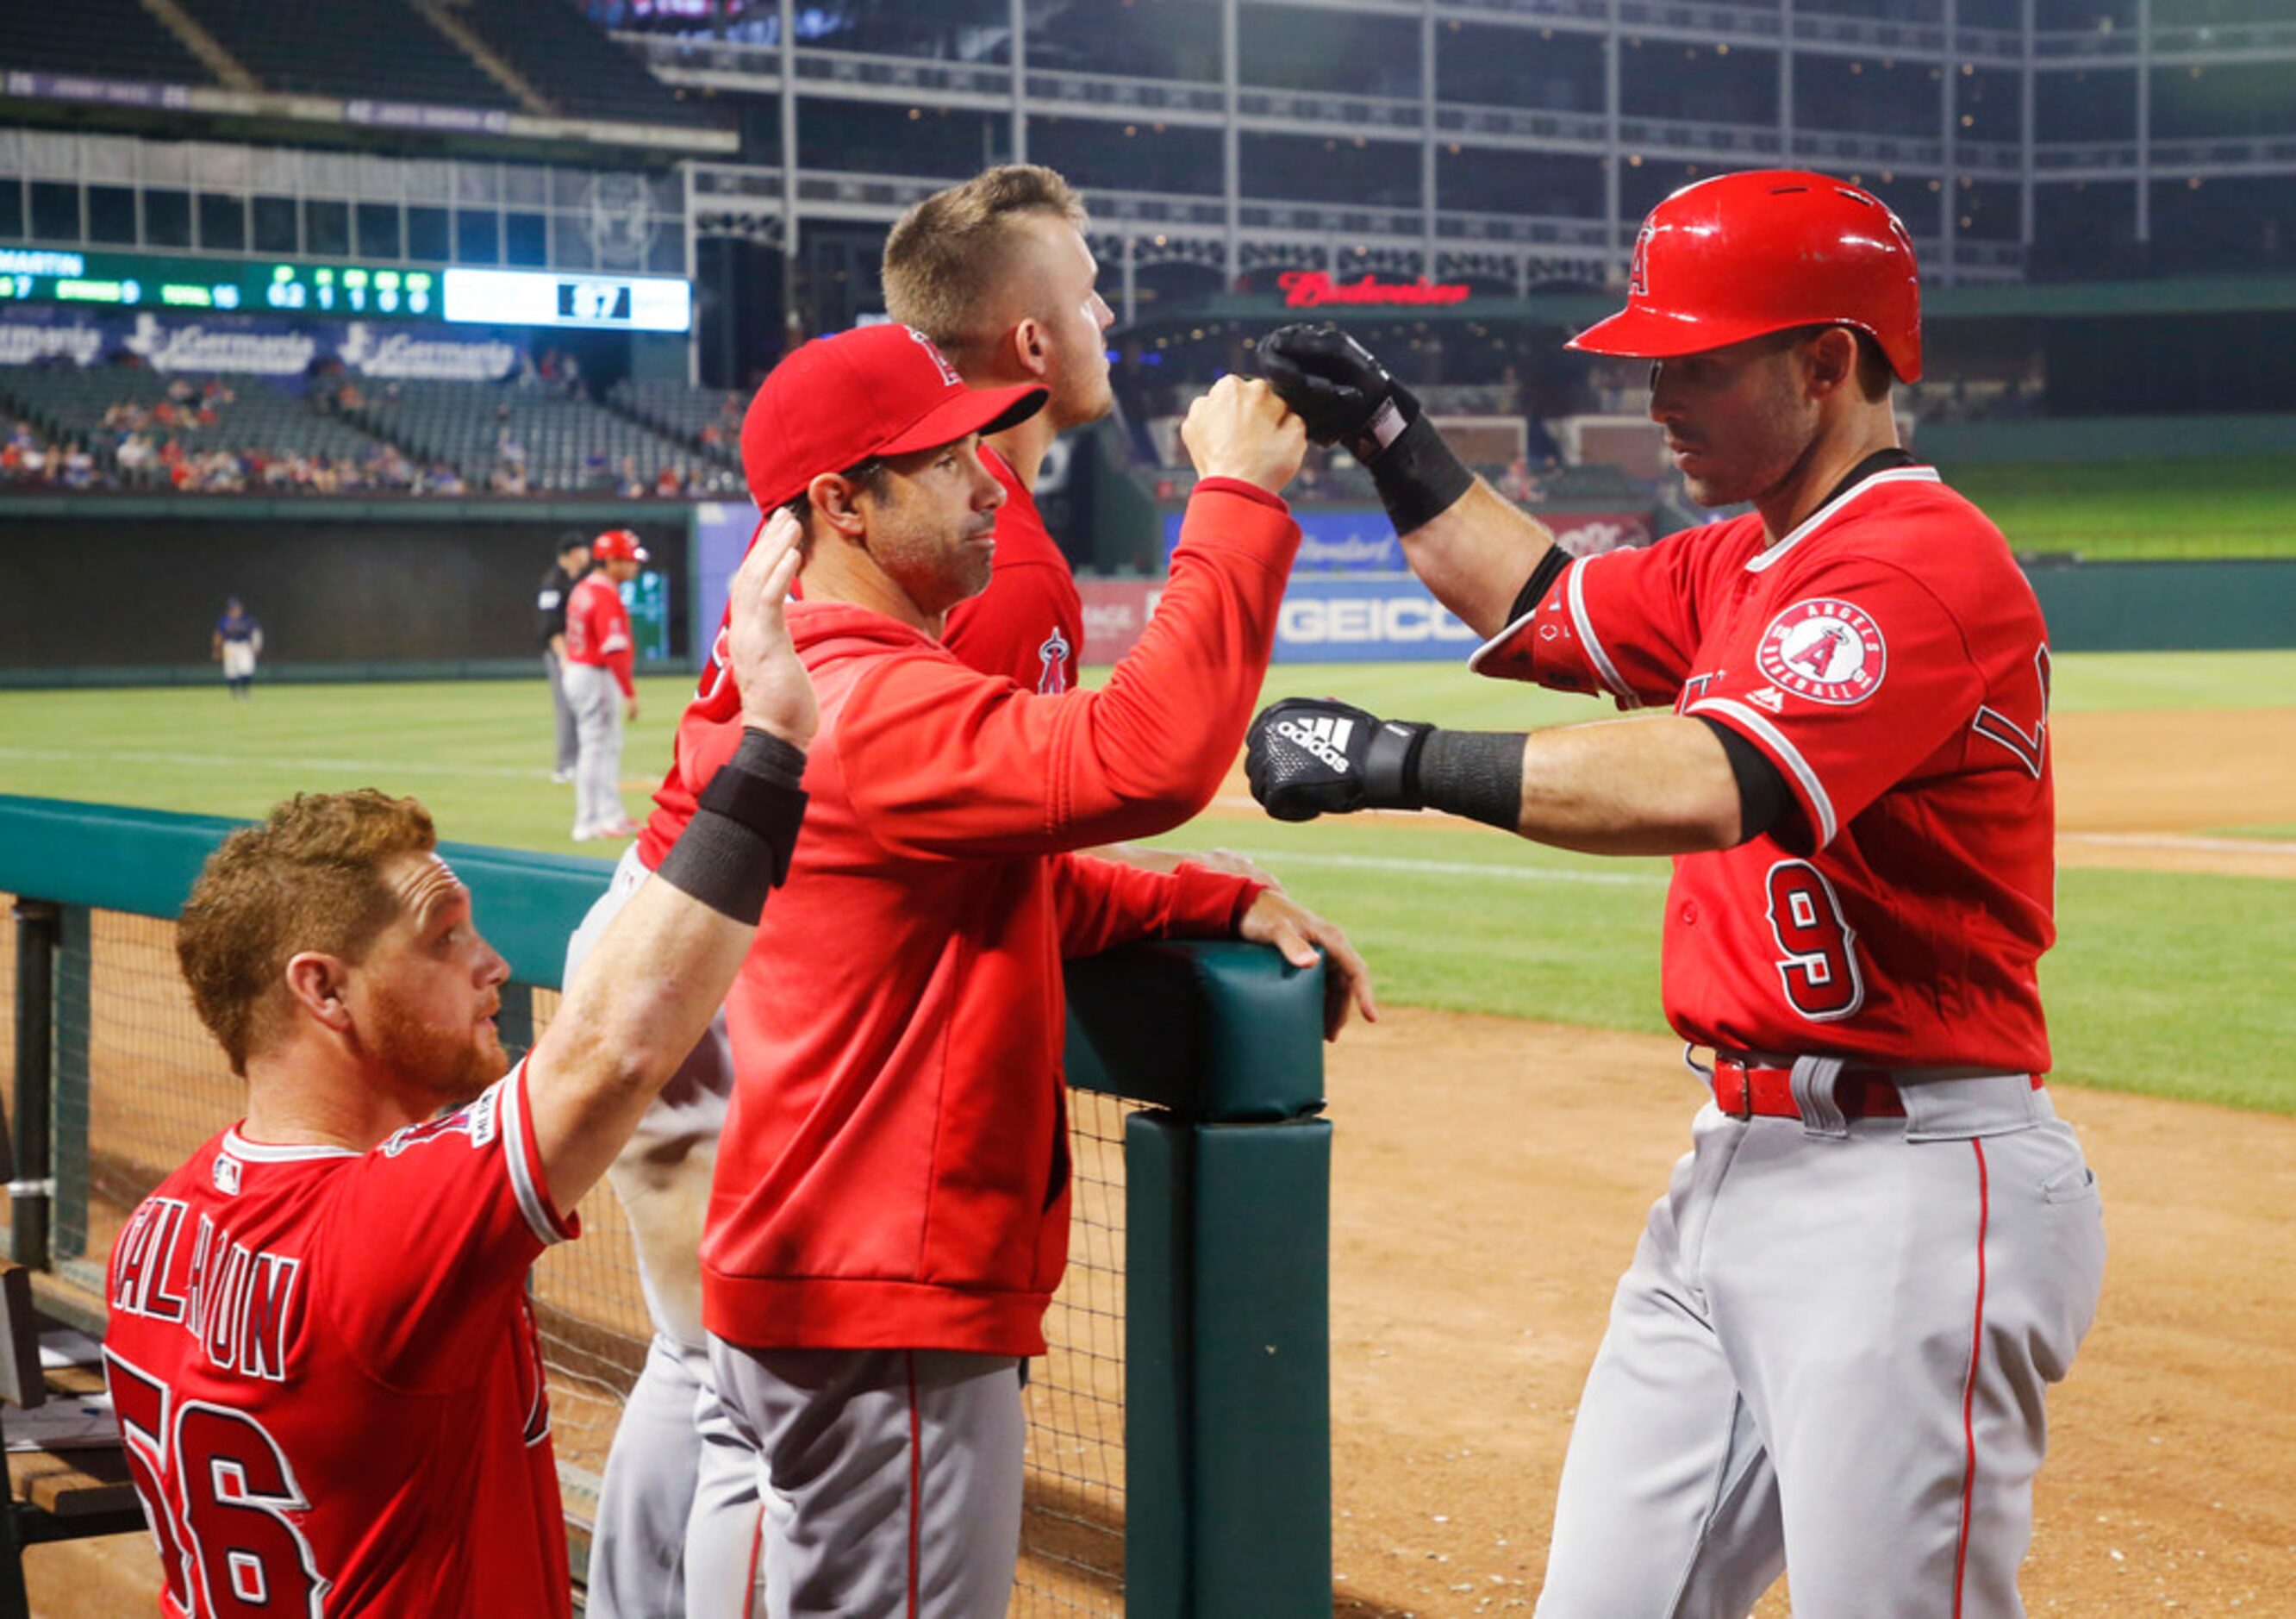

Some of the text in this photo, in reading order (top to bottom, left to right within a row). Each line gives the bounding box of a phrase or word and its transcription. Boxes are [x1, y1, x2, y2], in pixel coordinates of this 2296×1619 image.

[1277, 271, 1470, 308] Budweiser
[1806, 603, 1881, 653] ANGELS
[1763, 644, 1854, 699] BASEBALL
[1277, 721, 1350, 774] adidas
[1765, 858, 1864, 1022] 9
[101, 1344, 333, 1619] 56
